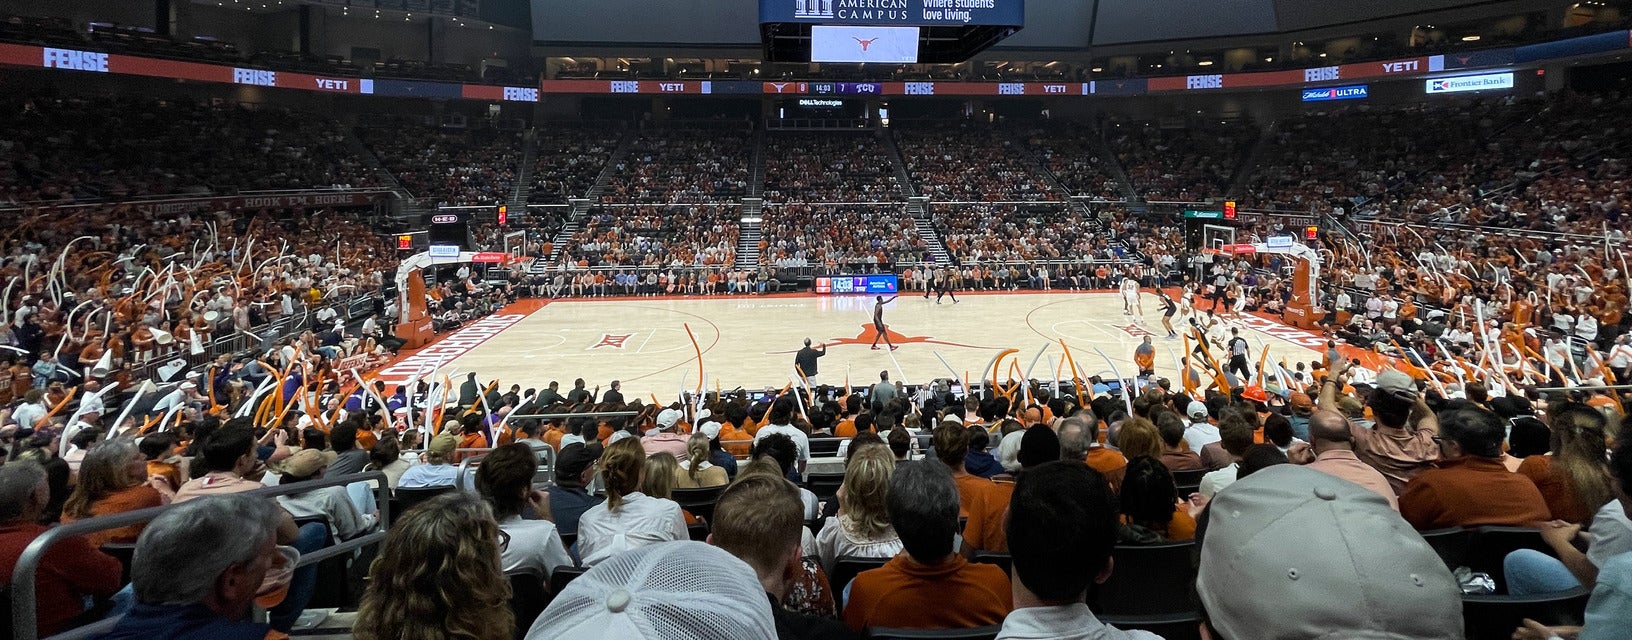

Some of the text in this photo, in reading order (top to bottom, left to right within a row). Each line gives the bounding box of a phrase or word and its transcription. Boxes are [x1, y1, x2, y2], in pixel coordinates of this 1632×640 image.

[839, 0, 907, 8] AMERICAN
[923, 0, 994, 8] Where students
[838, 9, 908, 20] CAMPUS
[923, 9, 943, 20] love
[43, 47, 109, 73] FENSE
[1382, 60, 1419, 73] YETI
[315, 78, 348, 90] YETI
[1186, 74, 1223, 89] FENSE
[1450, 76, 1506, 88] Frontier Bank
[659, 83, 684, 92] YETI
[856, 83, 875, 93] TCU
[904, 82, 934, 95] FENSE
[1043, 85, 1066, 93] YETI
[1336, 88, 1367, 97] ULTRA
[503, 86, 538, 102] FENSE
[314, 194, 353, 205] HORNS
[367, 397, 373, 407] 2
